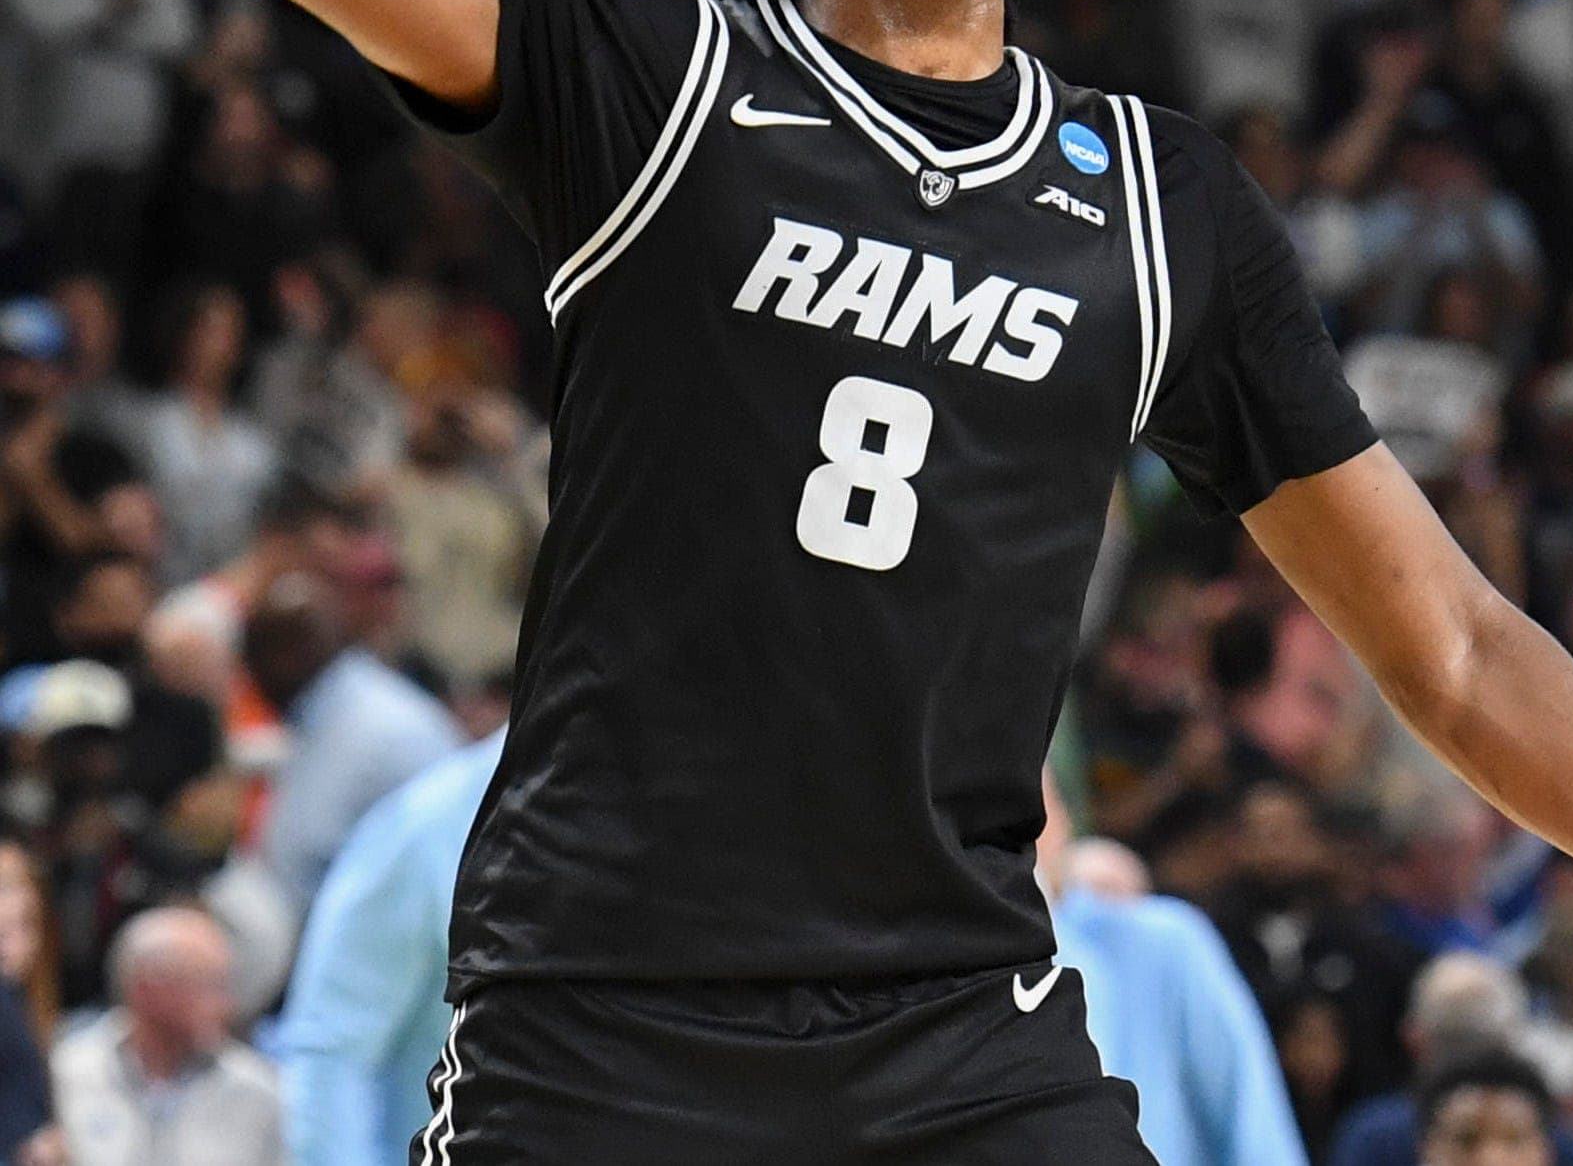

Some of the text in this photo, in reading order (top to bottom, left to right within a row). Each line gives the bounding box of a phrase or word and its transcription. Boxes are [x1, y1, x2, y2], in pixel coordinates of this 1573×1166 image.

[1064, 139, 1105, 166] NCAA
[1033, 184, 1105, 226] A10
[732, 217, 1079, 382] RAMS
[797, 376, 933, 570] 8
